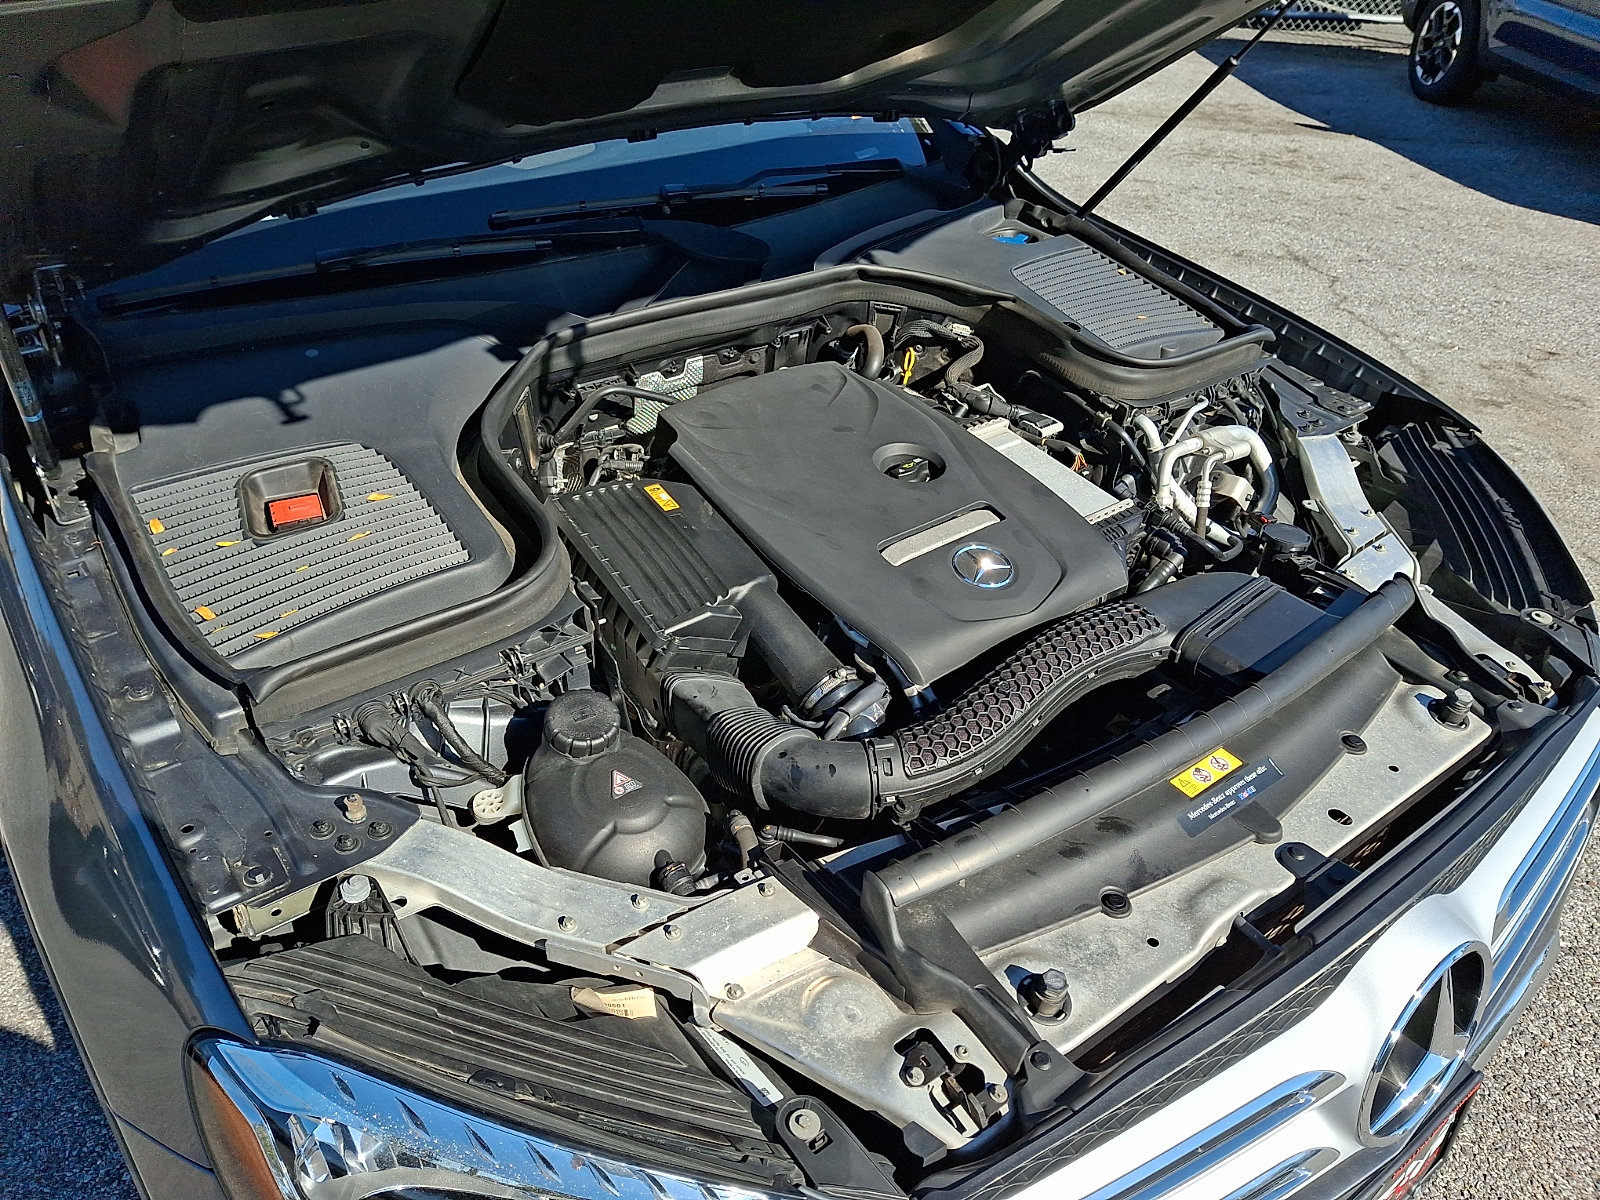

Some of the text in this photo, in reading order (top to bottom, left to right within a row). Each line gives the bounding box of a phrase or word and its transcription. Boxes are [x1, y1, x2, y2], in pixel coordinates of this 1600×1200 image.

[1187, 793, 1226, 820] Mercedes-Benz
[1225, 780, 1246, 796] approves
[1244, 771, 1258, 783] these
[1208, 800, 1236, 820] Mercedes-Benz
